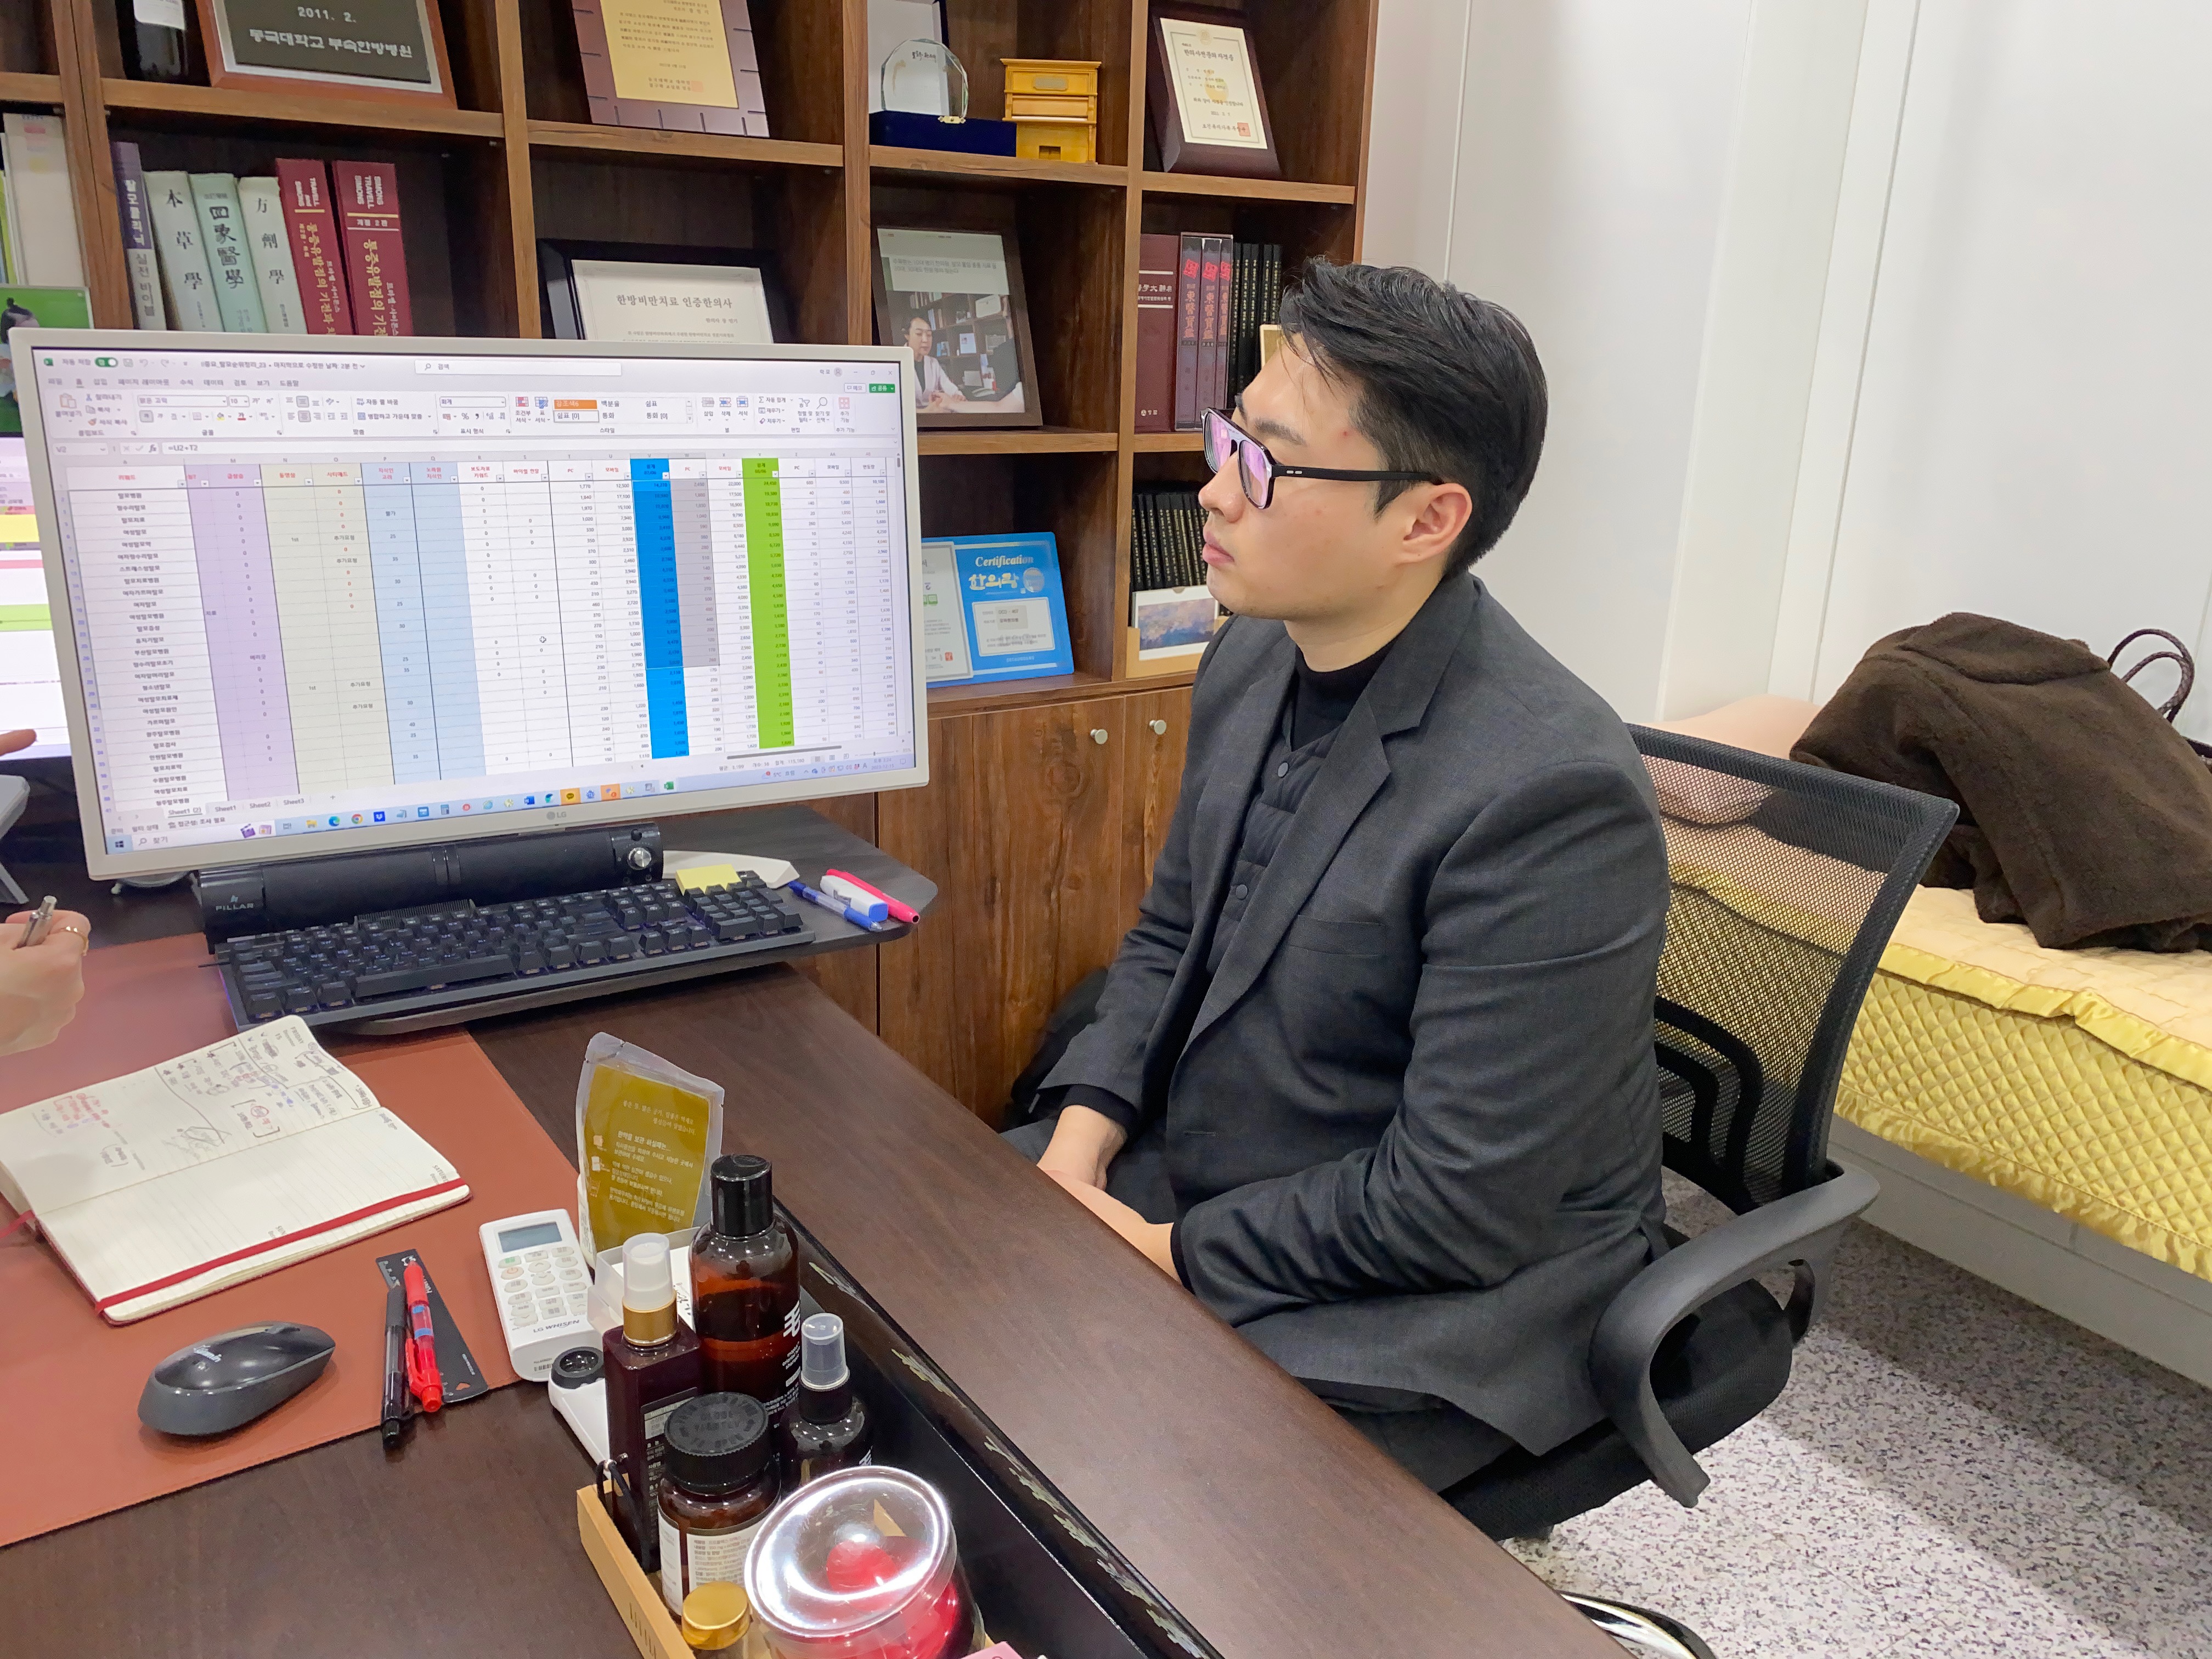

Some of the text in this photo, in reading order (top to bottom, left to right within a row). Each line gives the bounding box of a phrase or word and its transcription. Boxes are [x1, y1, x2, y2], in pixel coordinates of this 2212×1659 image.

[249, 29, 324, 49] 동국대학교
[295, 180, 304, 207] SIMONS
[309, 177, 320, 206] TRAVELL
[354, 175, 365, 206] SIMONS
[364, 174, 375, 210] TRAVELL
[374, 175, 384, 206] SIMONS
[306, 222, 328, 288] 통증유발점의
[363, 239, 386, 311] 통증유발점의
[616, 294, 732, 309] 한방비만치료 인증한의사
[975, 555, 1034, 568] Certification
[249, 800, 272, 809] Sheet2
[283, 797, 305, 806] Sheet3
[153, 836, 169, 844] 찾기
[290, 1026, 304, 1043] FRIDAY
[618, 1130, 633, 1141] 한약을
[634, 1136, 645, 1144] 보관
[545, 1319, 580, 1330] WHISEN
